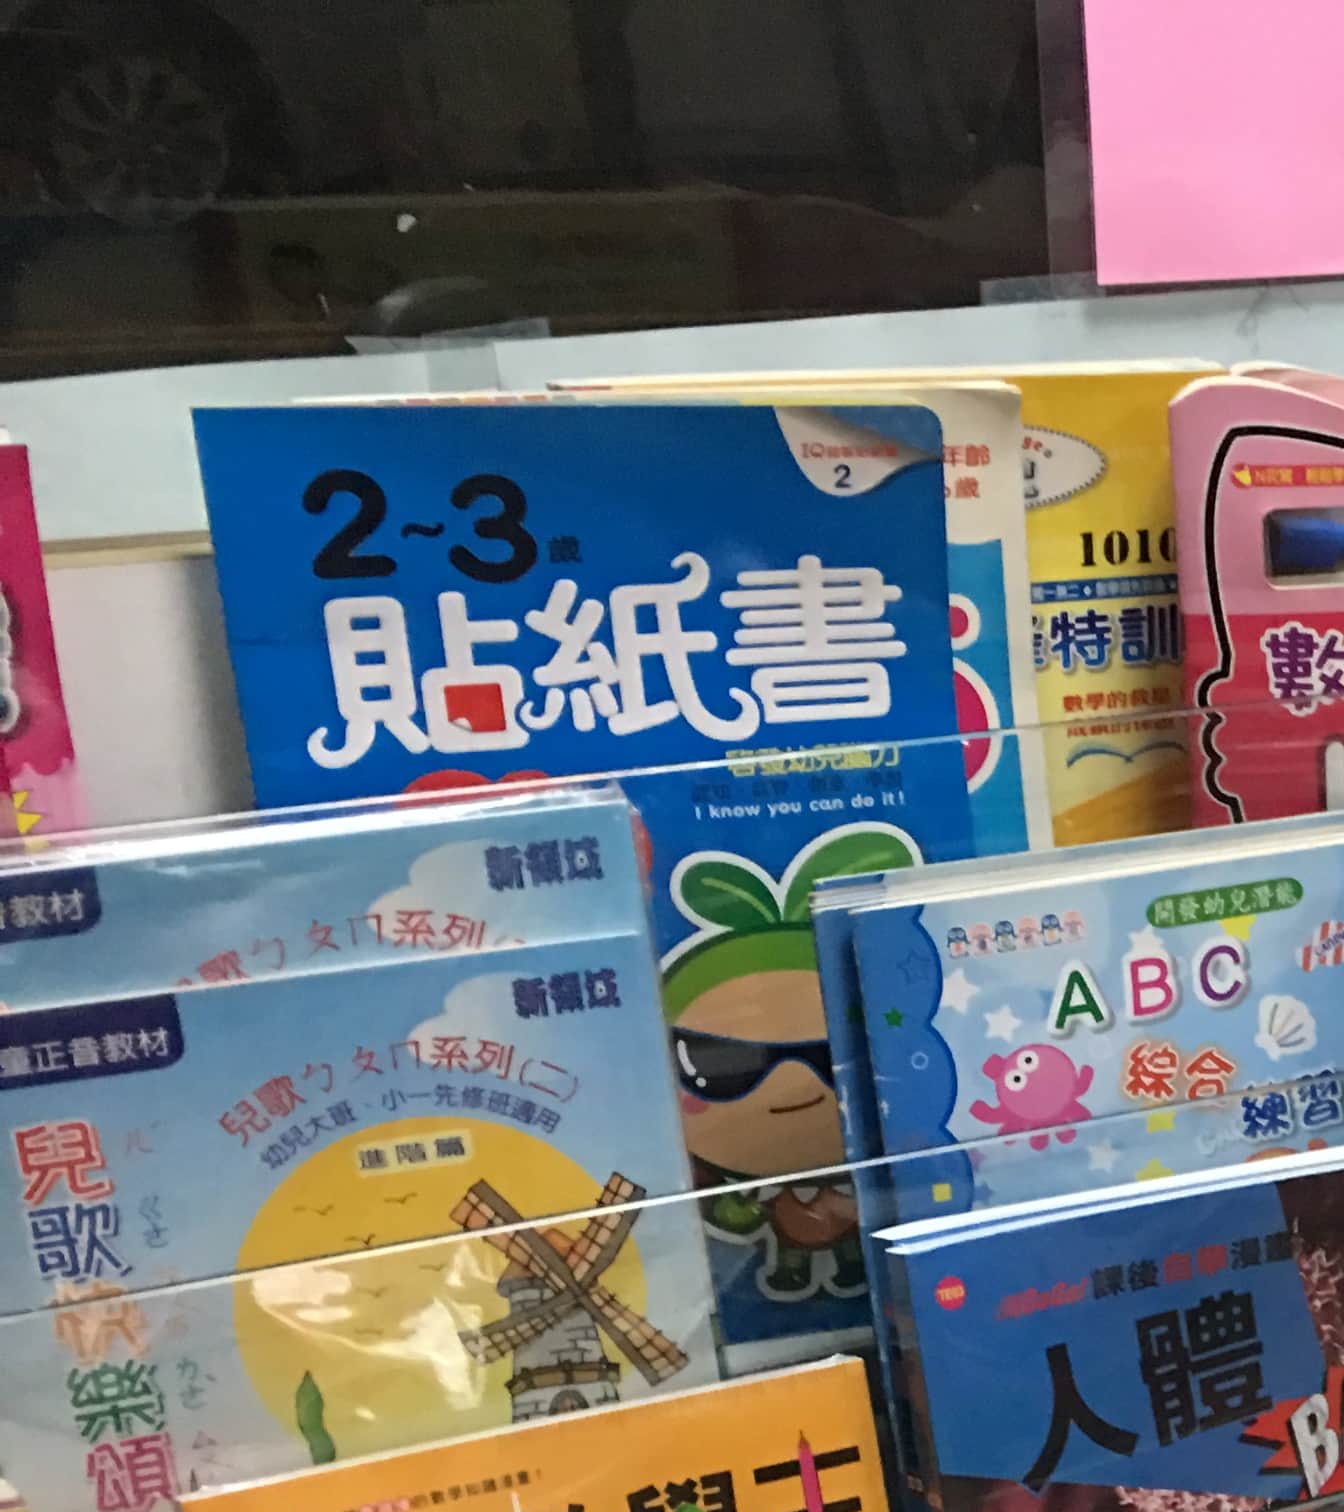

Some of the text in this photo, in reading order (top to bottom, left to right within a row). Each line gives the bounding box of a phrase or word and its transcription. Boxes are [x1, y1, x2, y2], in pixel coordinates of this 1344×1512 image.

[306, 551, 907, 770] 貼紙書
[708, 804, 762, 820] know
[766, 801, 802, 818] you
[808, 799, 844, 813] can
[850, 794, 875, 809] do
[484, 835, 604, 892] 新領域
[511, 967, 623, 1019] 新領域
[1051, 940, 1249, 1034] ABC
[1021, 1289, 1272, 1497] 人體
